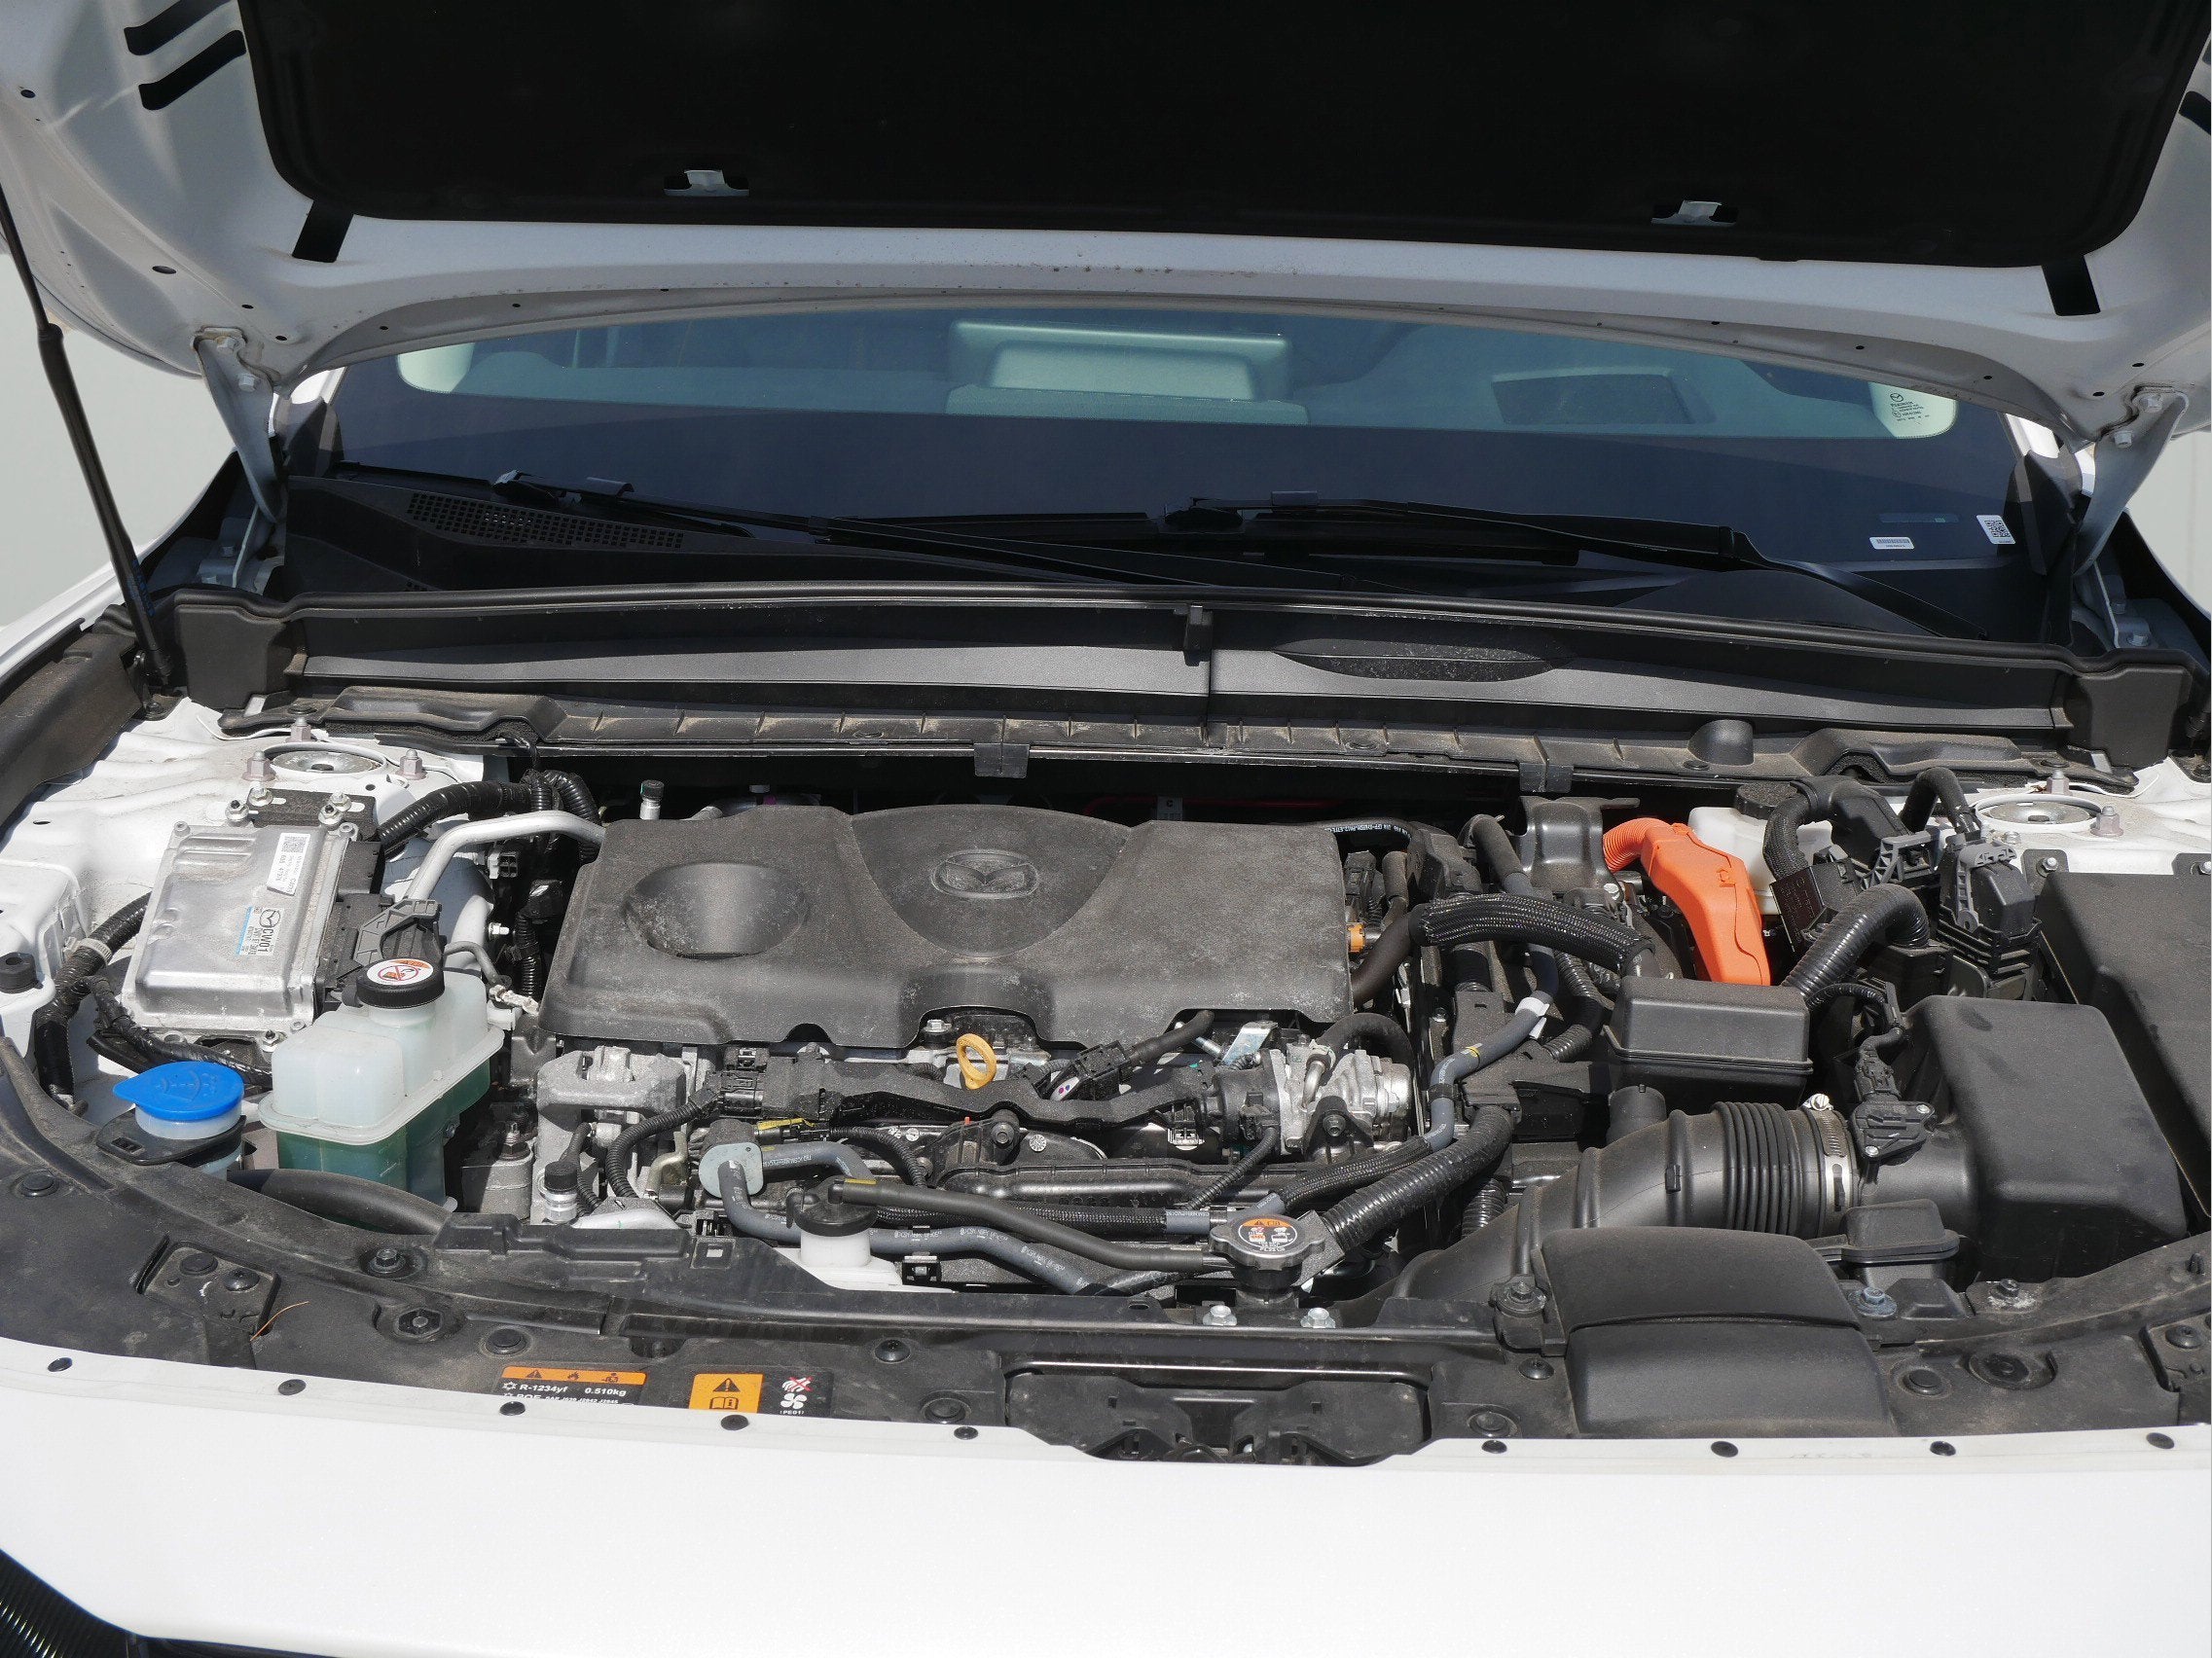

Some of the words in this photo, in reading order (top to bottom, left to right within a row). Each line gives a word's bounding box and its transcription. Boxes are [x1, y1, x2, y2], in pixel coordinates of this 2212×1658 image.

[258, 928, 274, 953] CW01
[519, 1384, 569, 1393] R-1234yf
[584, 1388, 628, 1397] 0.510kg
